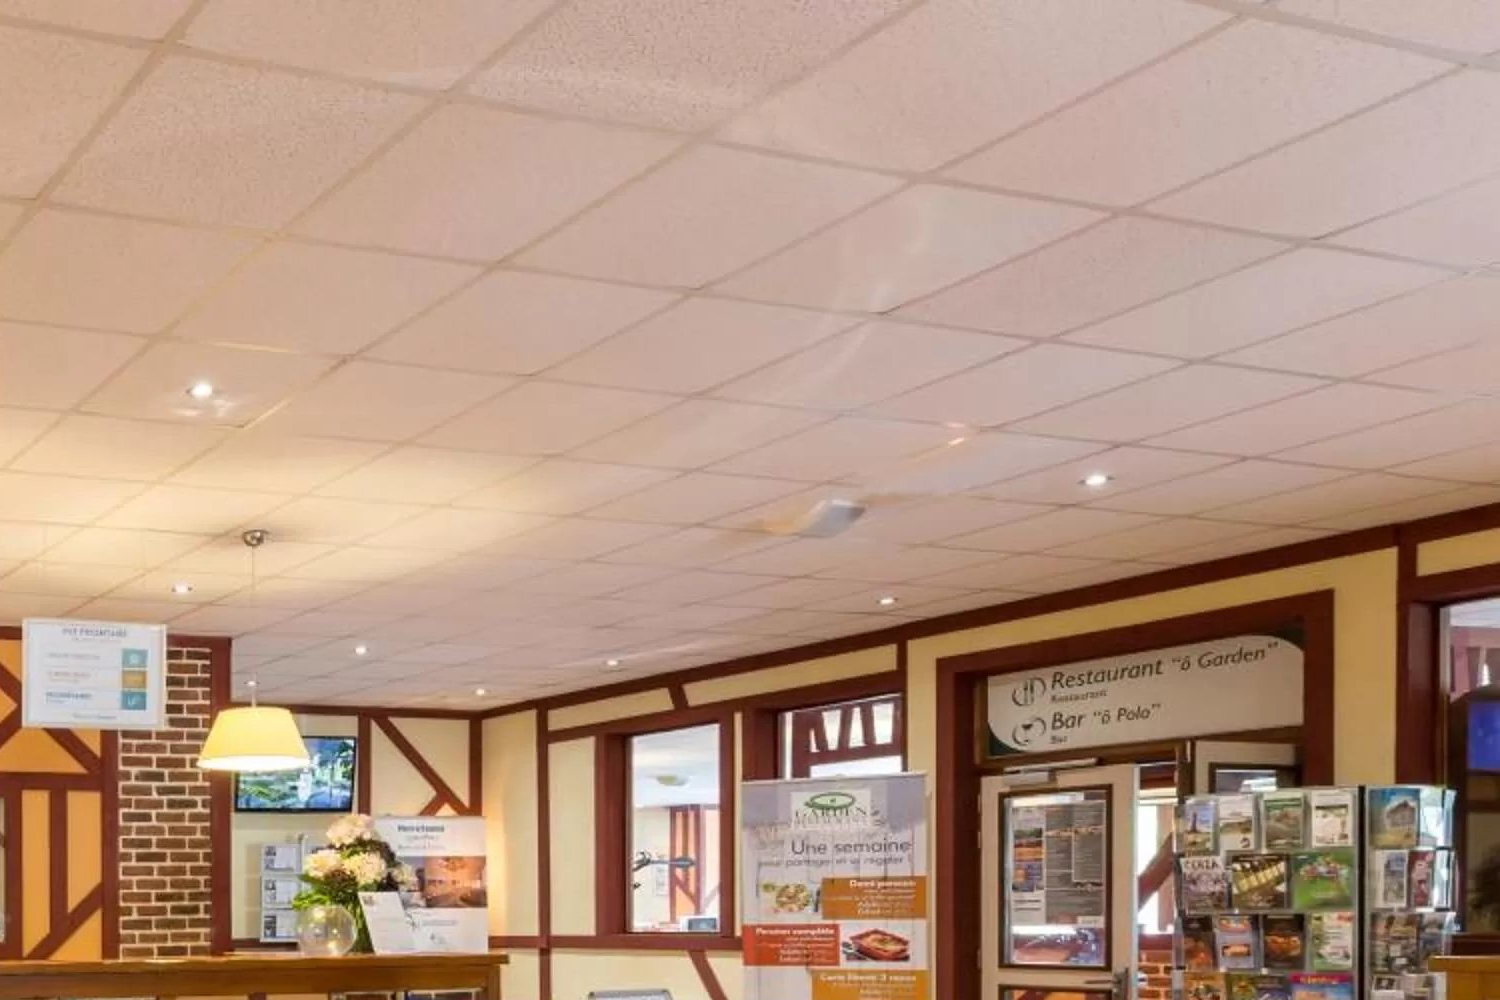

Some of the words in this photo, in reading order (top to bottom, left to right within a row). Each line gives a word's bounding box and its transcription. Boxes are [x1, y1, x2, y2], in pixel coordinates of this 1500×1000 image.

[1051, 659, 1164, 690] Restaurant
[1051, 711, 1086, 731] Bar
[791, 838, 827, 855] Une
[834, 837, 911, 854] semaine
